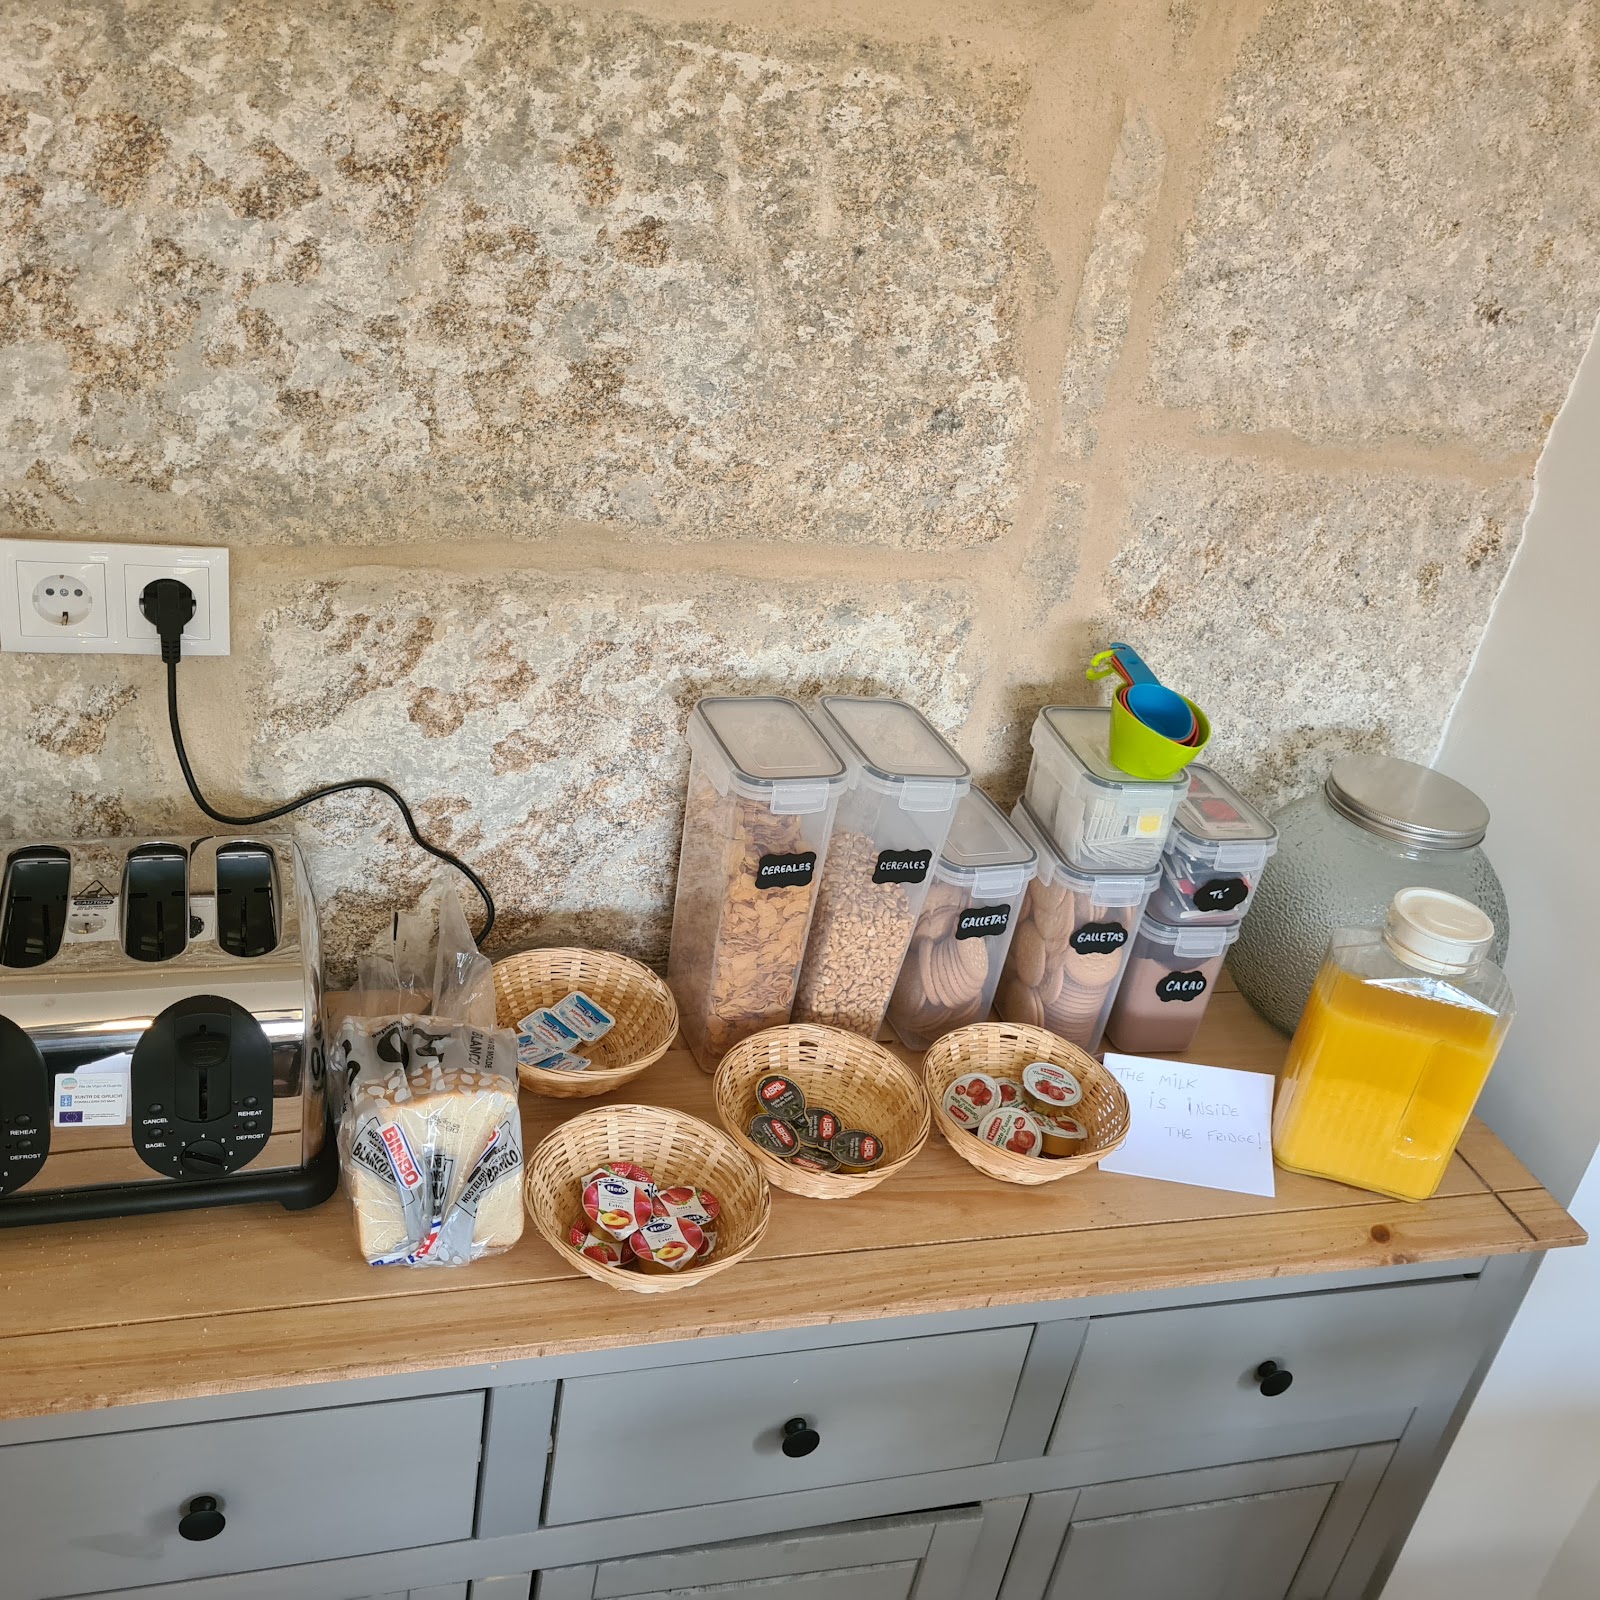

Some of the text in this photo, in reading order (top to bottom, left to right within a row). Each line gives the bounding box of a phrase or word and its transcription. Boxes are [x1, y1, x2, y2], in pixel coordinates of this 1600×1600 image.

[761, 862, 811, 876] CEREALES
[879, 860, 926, 870] CEREALES
[961, 914, 1008, 929] GALLETAS
[1077, 932, 1124, 943] GALLETAS
[1165, 980, 1204, 992] CACAO
[468, 1030, 483, 1066] BLANCO
[485, 1050, 494, 1069] MOLDE
[1115, 1068, 1145, 1082] THE
[763, 1081, 785, 1099] ABRIL
[771, 1120, 792, 1145] ABRIL
[823, 1116, 833, 1138] ABRIL
[988, 1118, 1001, 1140] Helios
[1164, 1126, 1193, 1140] THE
[236, 1133, 265, 1141] DEFROST
[382, 1126, 419, 1185] BIMBO
[863, 1138, 874, 1159] ABRIL
[10, 1153, 41, 1161] DEFROST
[606, 1185, 627, 1194] Hero
[650, 1223, 671, 1232] Hero
